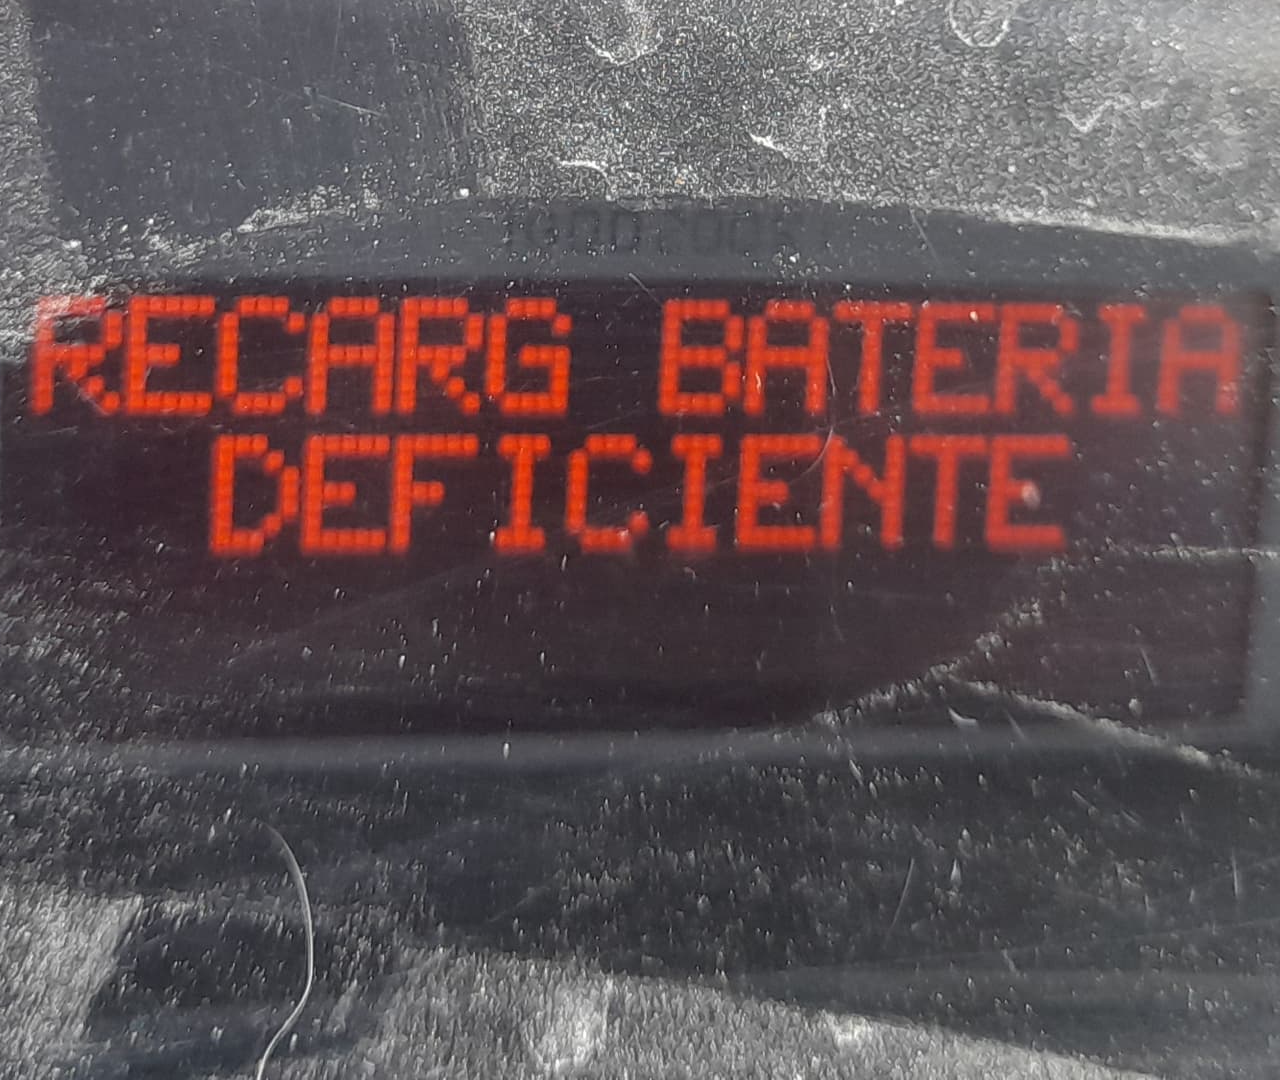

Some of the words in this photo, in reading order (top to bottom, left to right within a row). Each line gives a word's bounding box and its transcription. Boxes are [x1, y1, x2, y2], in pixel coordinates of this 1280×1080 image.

[28, 296, 574, 418] RECARG
[656, 298, 1245, 420] BATERIA
[208, 432, 1073, 556] DEFICIENTE
